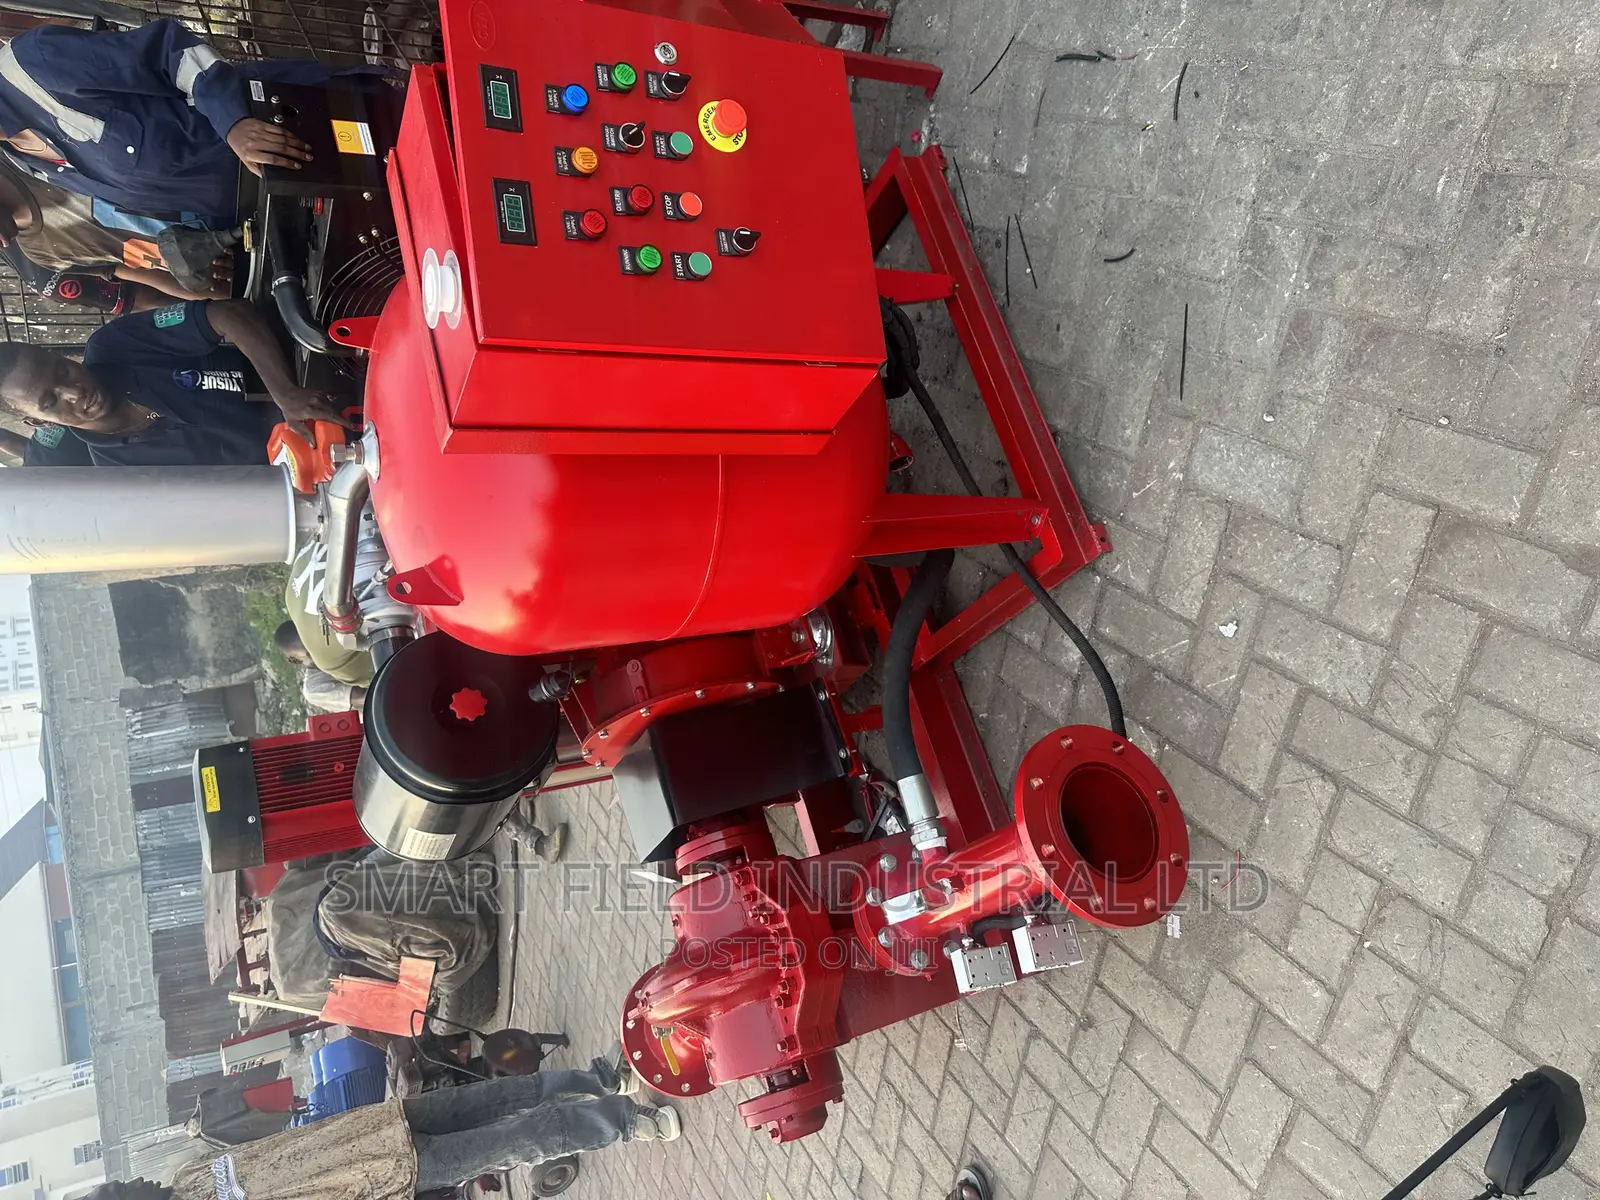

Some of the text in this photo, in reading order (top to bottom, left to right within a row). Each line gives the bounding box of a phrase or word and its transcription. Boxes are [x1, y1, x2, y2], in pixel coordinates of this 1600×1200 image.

[702, 105, 717, 141] EMERGEN
[732, 131, 744, 145] STO
[561, 151, 569, 170] SUPPLY
[664, 195, 673, 216] STOP
[570, 215, 578, 235] SUPPLY
[201, 374, 241, 392] YUSUF
